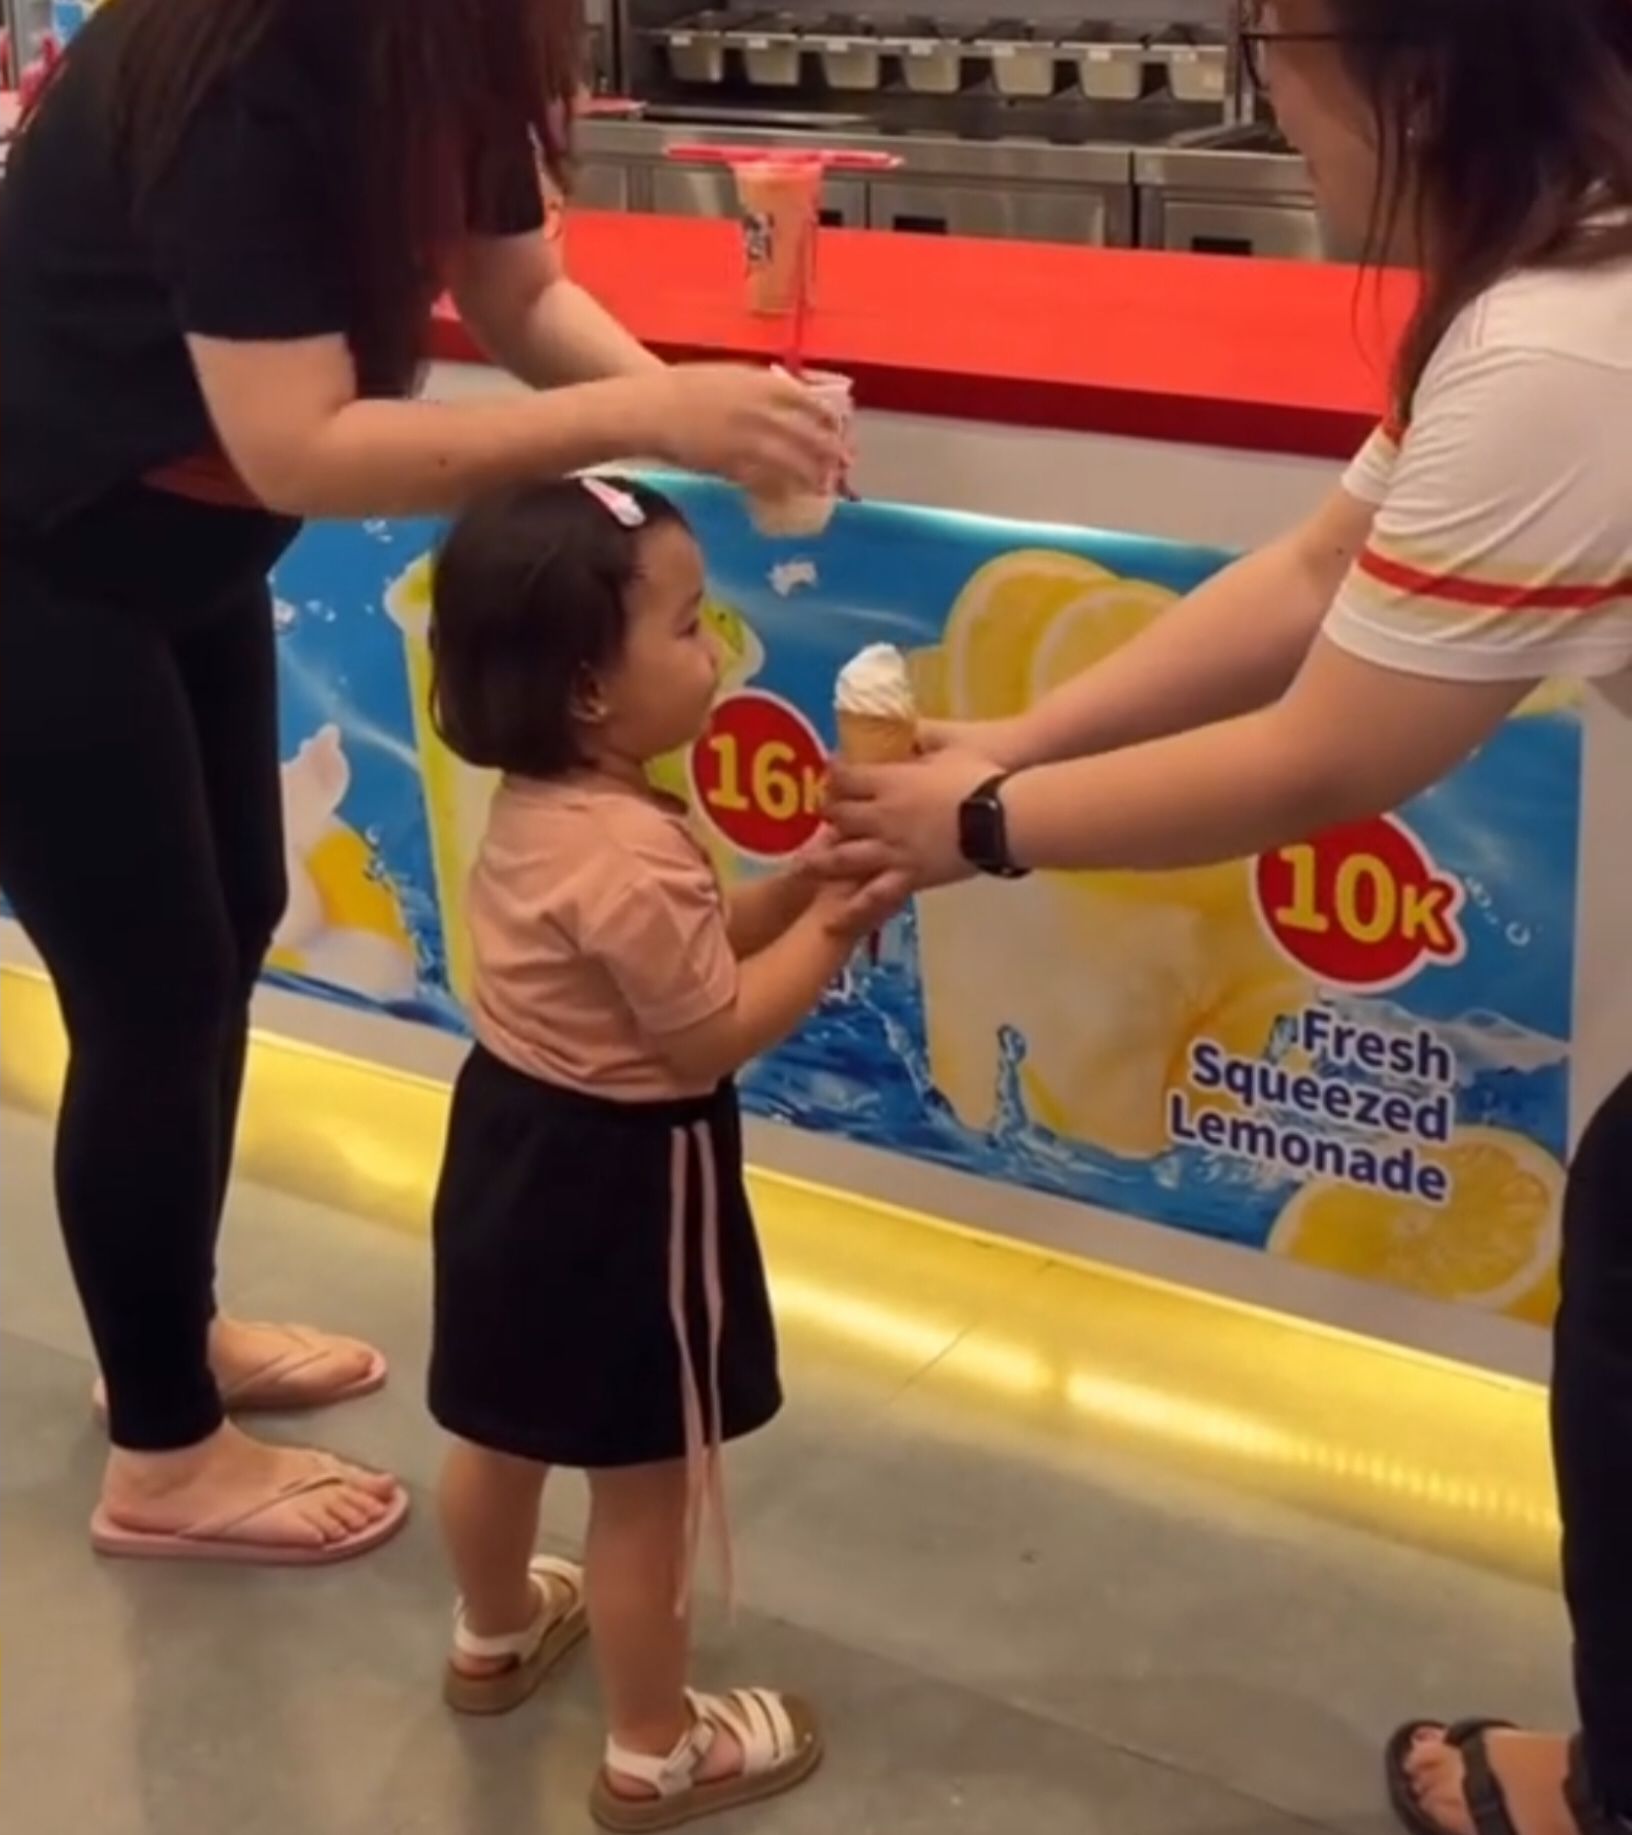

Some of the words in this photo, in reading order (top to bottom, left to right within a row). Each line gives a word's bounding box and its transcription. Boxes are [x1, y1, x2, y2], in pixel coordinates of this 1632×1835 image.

[1275, 844, 1447, 946] 10K
[1192, 1044, 1449, 1141] Squeezed
[1303, 1010, 1449, 1080] Fresh
[1170, 1095, 1448, 1201] Lemonade
